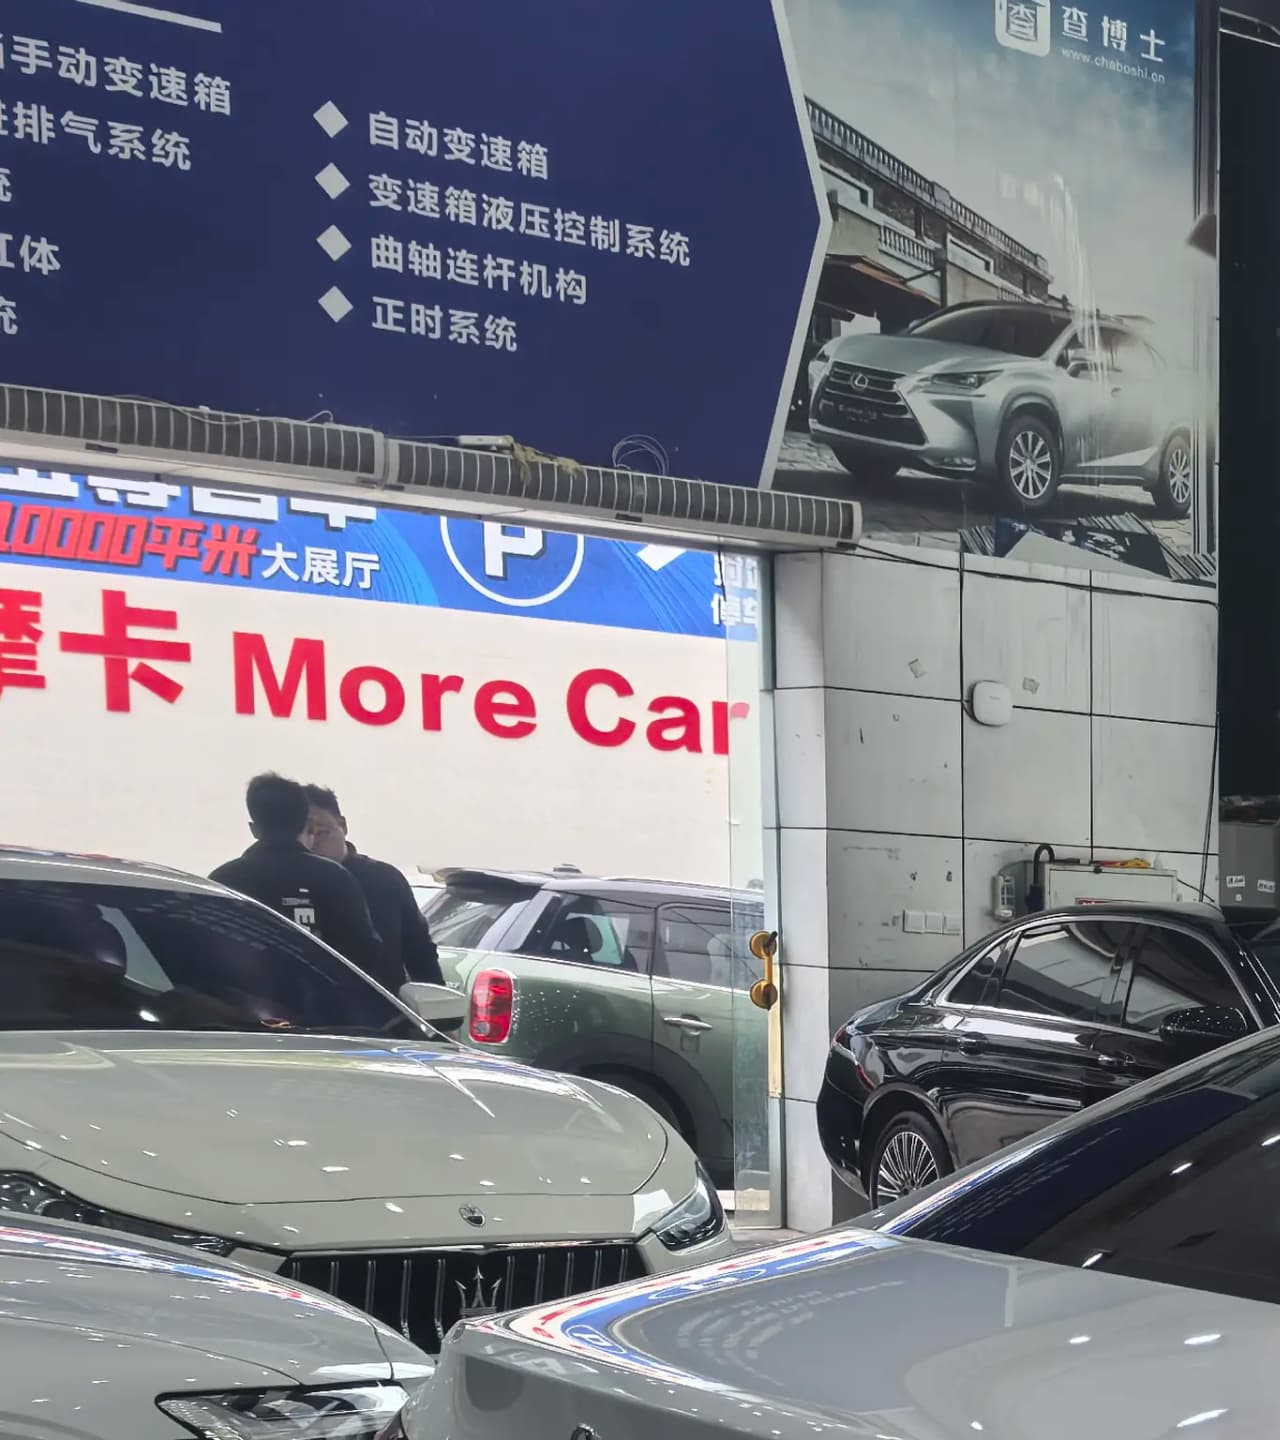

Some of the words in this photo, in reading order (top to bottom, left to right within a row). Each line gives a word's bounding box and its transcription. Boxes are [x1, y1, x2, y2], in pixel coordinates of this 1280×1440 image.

[1061, 5, 1166, 62] 查博士
[1061, 47, 1166, 84] www.chaboshi.cn
[0, 101, 191, 170] 排气系统
[369, 110, 549, 180] 自动变速箱
[368, 173, 691, 267] 变速箱液压控制系统
[371, 234, 587, 305] 曲轴连杆机构
[372, 296, 518, 352] 正时系统
[261, 542, 381, 590] 大展厅
[232, 631, 537, 739] More
[566, 668, 751, 755] Car
